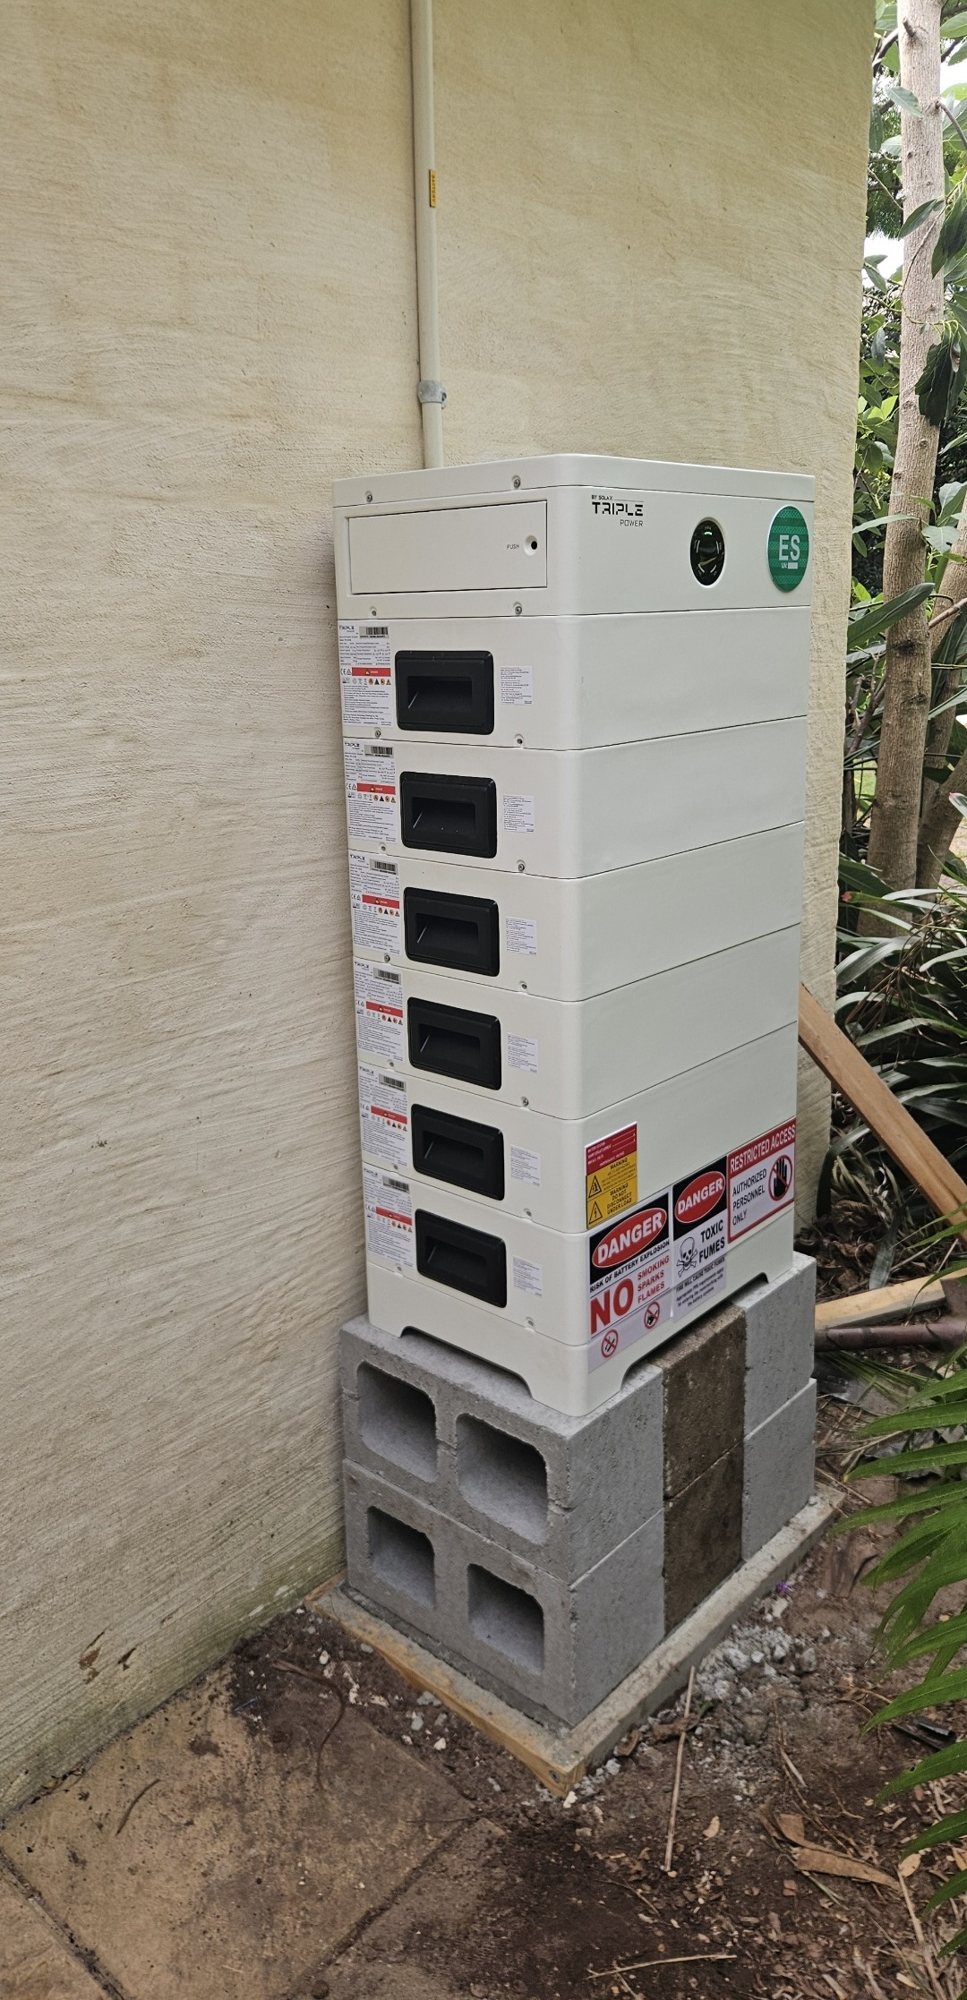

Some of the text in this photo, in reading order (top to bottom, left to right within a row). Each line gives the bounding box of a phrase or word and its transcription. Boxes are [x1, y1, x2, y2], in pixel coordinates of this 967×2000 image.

[592, 502, 643, 516] TRIPLE
[779, 534, 800, 561] ES
[730, 1125, 795, 1173] RESTRICTED ACCESS
[677, 1177, 723, 1215] DANGER
[732, 1168, 767, 1197] AUTHORIZED
[732, 1185, 765, 1211] PERSONNEL
[732, 1208, 747, 1226] ONLY
[597, 1211, 663, 1264] DANGER
[700, 1220, 724, 1244] TOXIC
[699, 1236, 725, 1263] FUMES
[590, 1240, 670, 1293] RISK OF BATTERY EXPLOSION
[637, 1255, 669, 1280] SMOKING
[637, 1270, 664, 1292] SPARKS
[637, 1281, 665, 1304] FLAMES
[590, 1278, 634, 1335] NO
